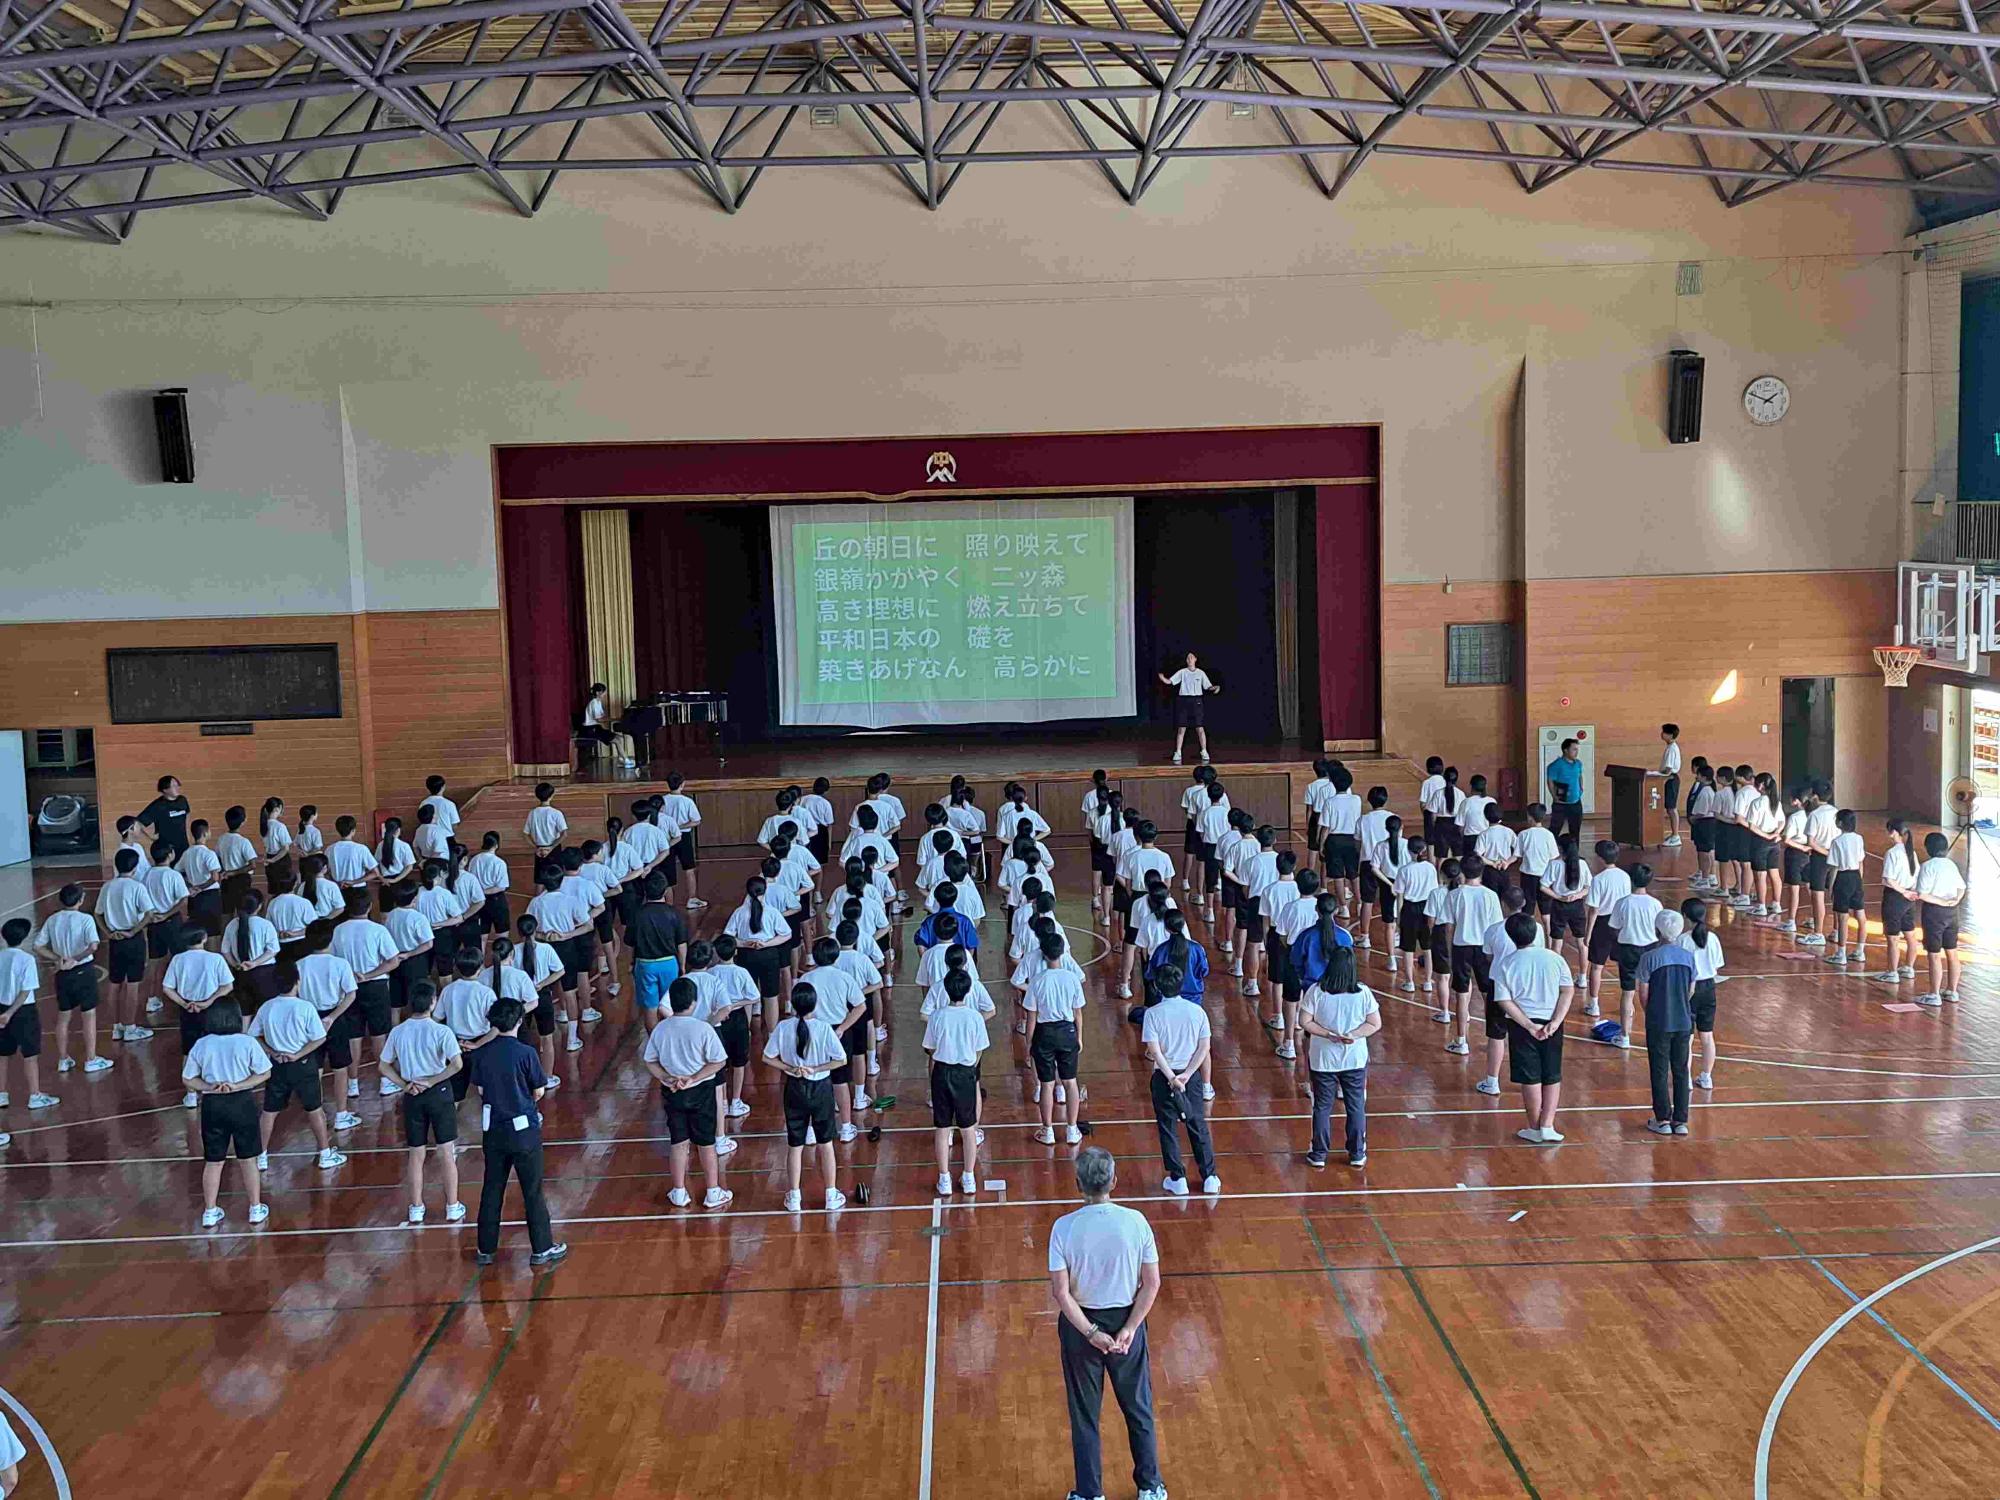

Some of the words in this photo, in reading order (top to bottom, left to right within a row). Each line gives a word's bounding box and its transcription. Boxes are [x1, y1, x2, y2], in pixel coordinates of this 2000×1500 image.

[814, 535, 938, 561] 丘の朝日に
[966, 532, 1089, 559] 照り映えて
[814, 565, 960, 592] 銀嶺かがやく
[816, 596, 940, 623] 高き理想に
[967, 594, 1089, 619] 燃え立ちて
[817, 626, 941, 652] 平和日本の
[967, 625, 1014, 649] 礎を
[818, 656, 968, 682] 築きあげなん
[993, 654, 1091, 679] 高らかに
